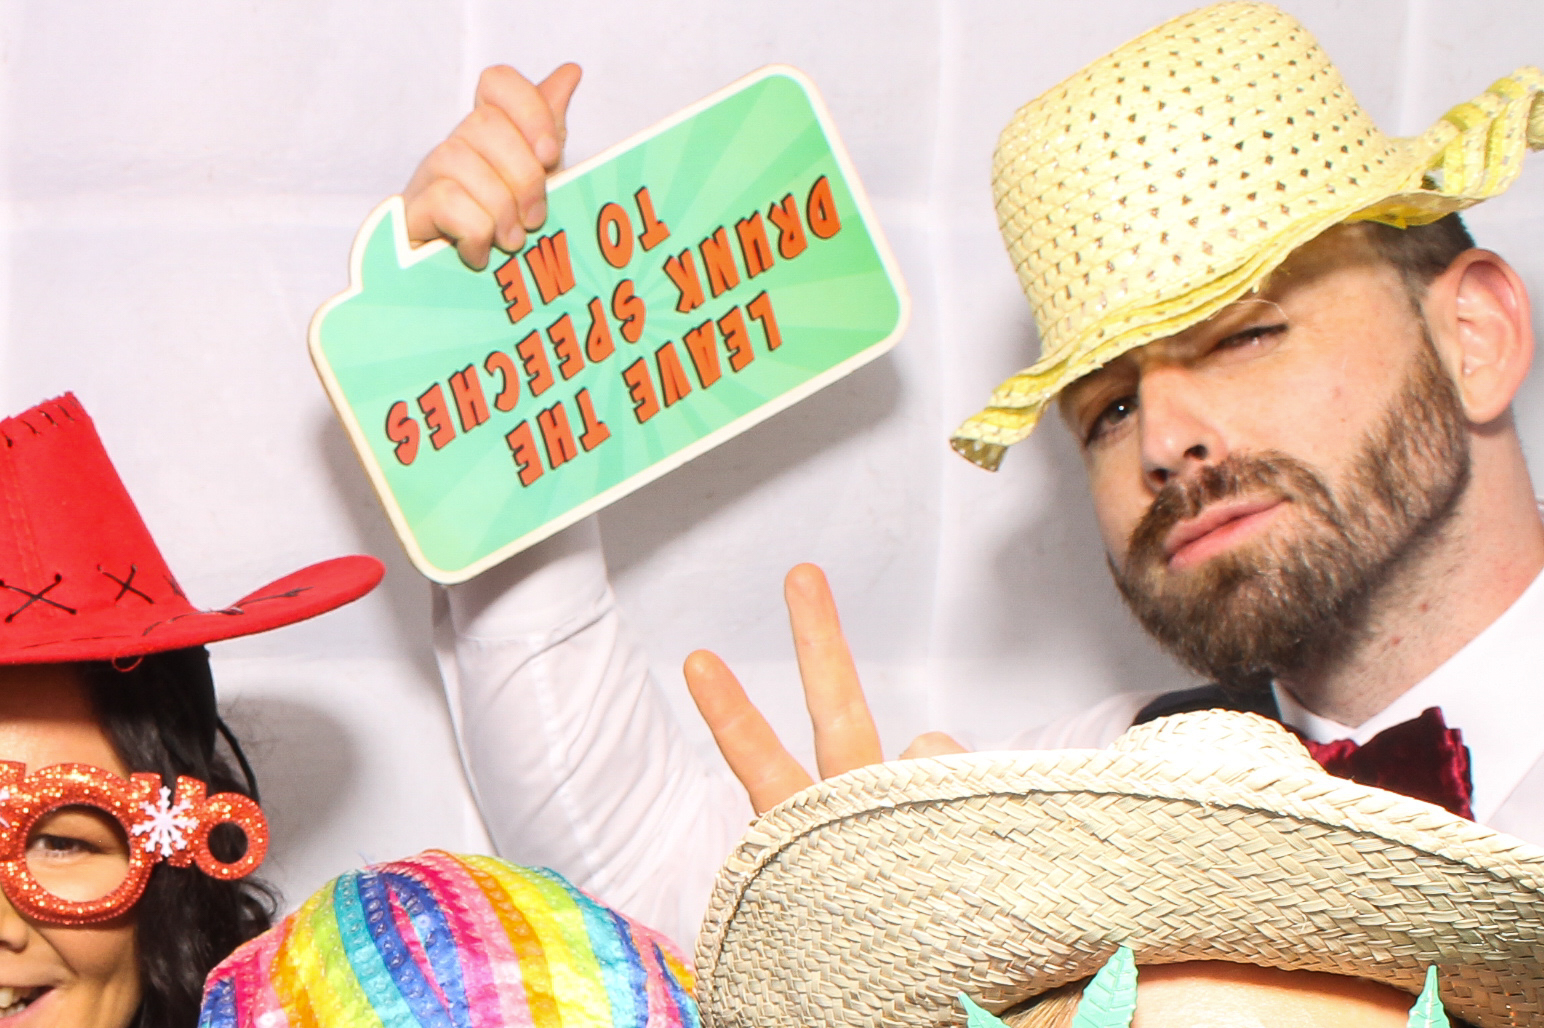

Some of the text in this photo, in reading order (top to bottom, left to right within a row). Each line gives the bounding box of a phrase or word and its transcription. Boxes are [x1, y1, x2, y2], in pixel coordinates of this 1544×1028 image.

[384, 174, 843, 467] DRUNK SPEECHES
[492, 185, 672, 325] TO ME
[504, 289, 784, 488] LEAVE THE
